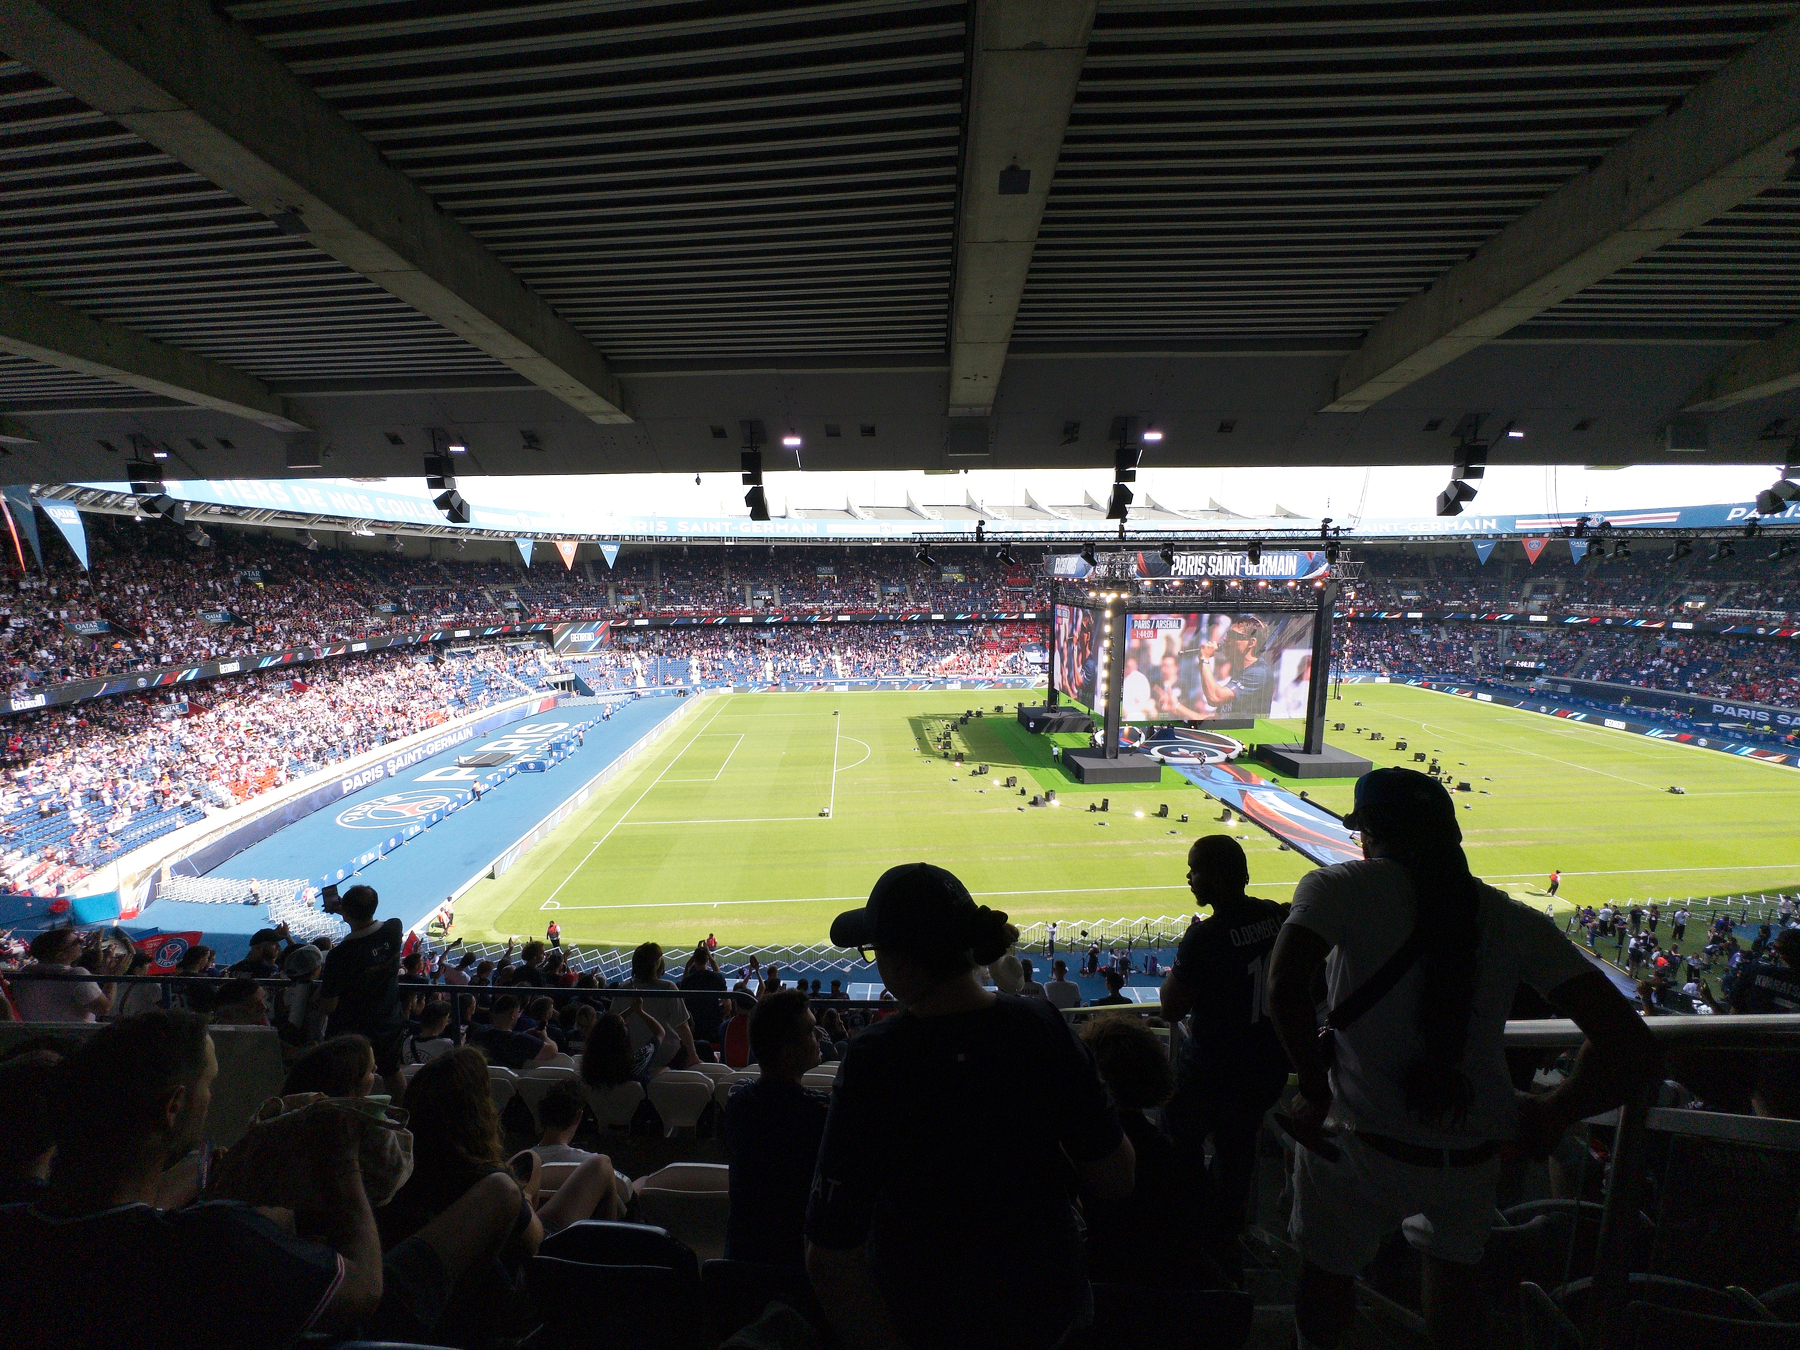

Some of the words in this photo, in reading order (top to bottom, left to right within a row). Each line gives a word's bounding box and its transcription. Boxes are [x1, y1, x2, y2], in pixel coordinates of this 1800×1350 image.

[209, 480, 291, 502] FIERS
[290, 484, 329, 507] DE
[327, 490, 375, 512] NOS
[376, 497, 446, 520] COULEU
[1726, 503, 1800, 521] PAI
[677, 521, 818, 534] SAINT-GERMAIN
[1171, 555, 1207, 576] PARIS
[75, 622, 99, 630] QATAR
[1133, 619, 1151, 629] PARIS
[1155, 619, 1180, 629] ARSENAL
[1712, 704, 1770, 722] PARIS
[342, 764, 384, 794] PARIS
[386, 727, 473, 775] SAINT-GERMAIN
[413, 722, 570, 782] PRIS
[1229, 914, 1284, 948] O.DEMBÉL
